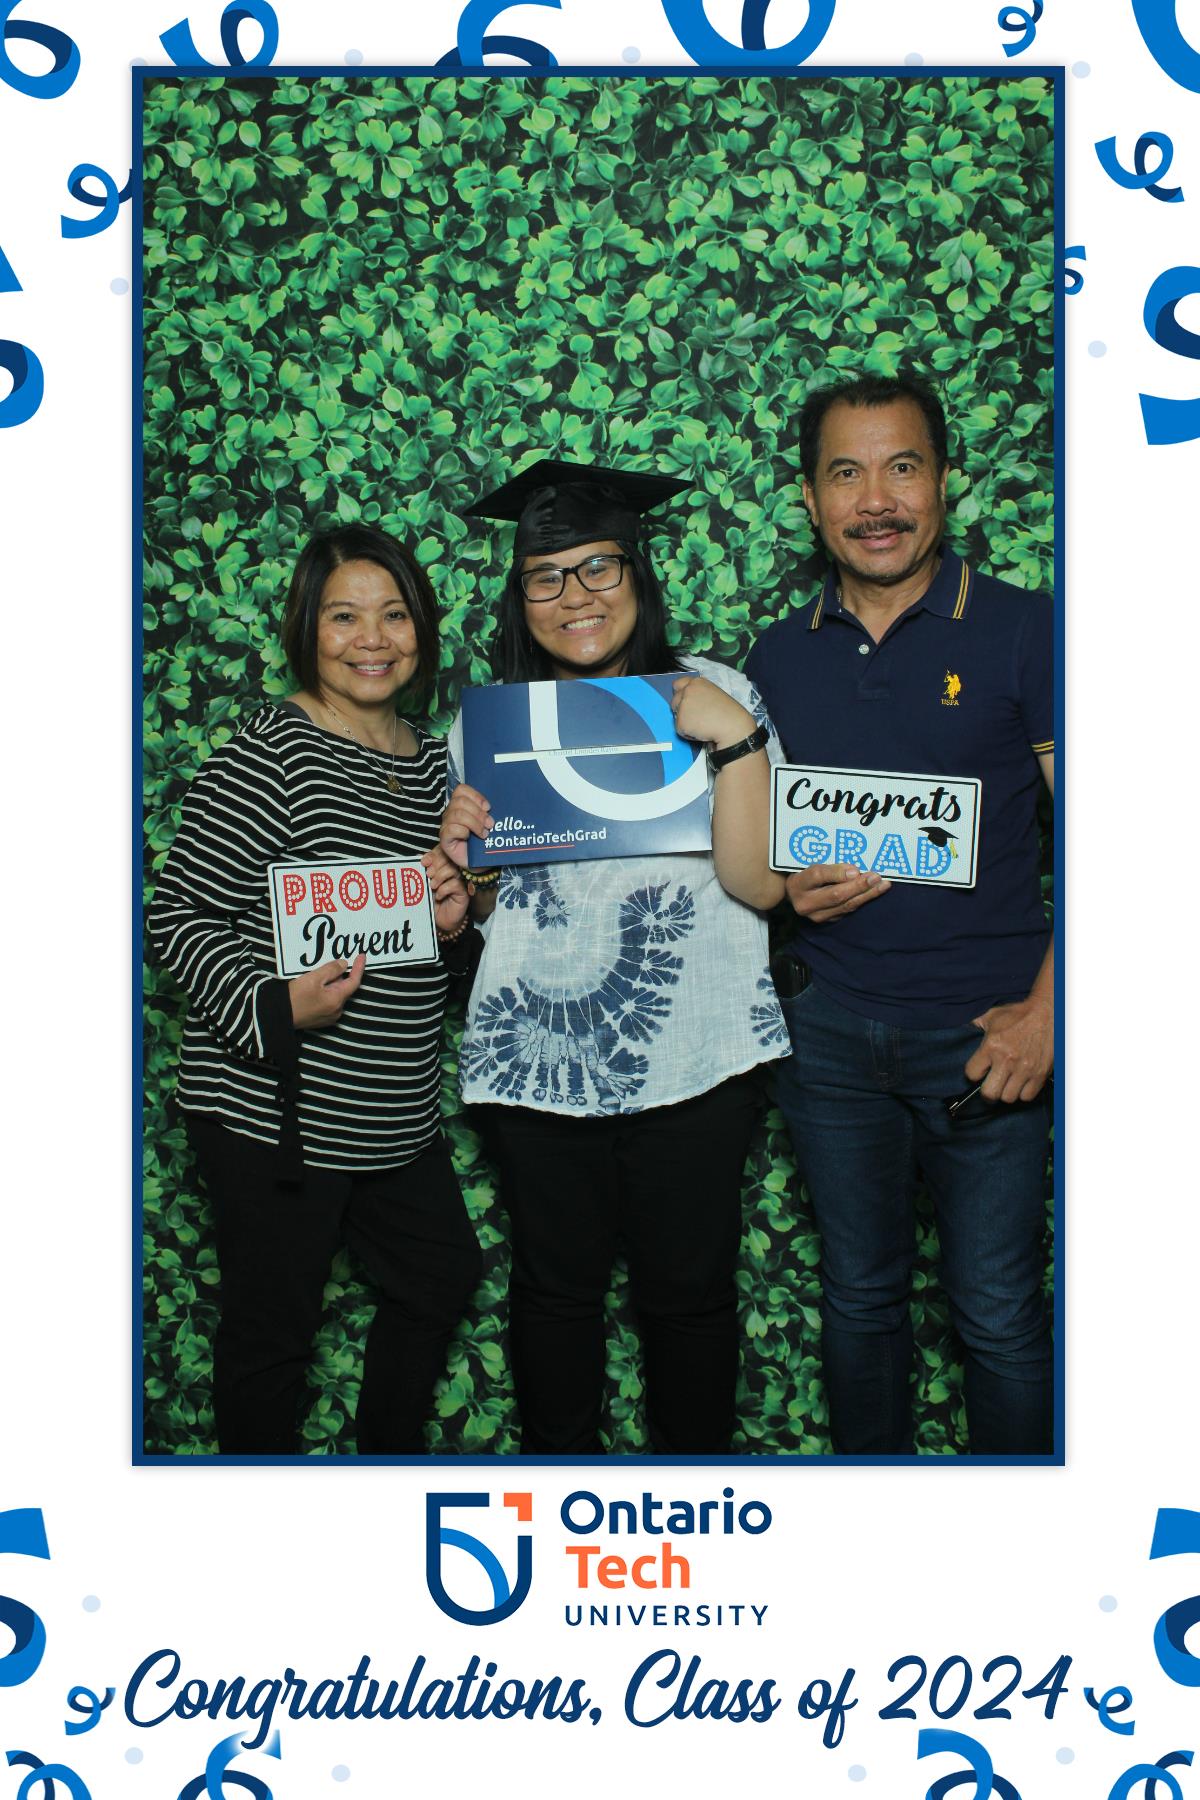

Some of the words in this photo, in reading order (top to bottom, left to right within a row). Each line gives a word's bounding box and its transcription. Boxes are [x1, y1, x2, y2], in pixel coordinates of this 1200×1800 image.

[490, 816, 535, 832] ello...
[786, 777, 962, 827] Congrats
[484, 826, 607, 849] #OntarioTechGrad
[789, 825, 952, 878] GRAD
[282, 867, 425, 916] PROUD
[299, 913, 414, 967] Parent
